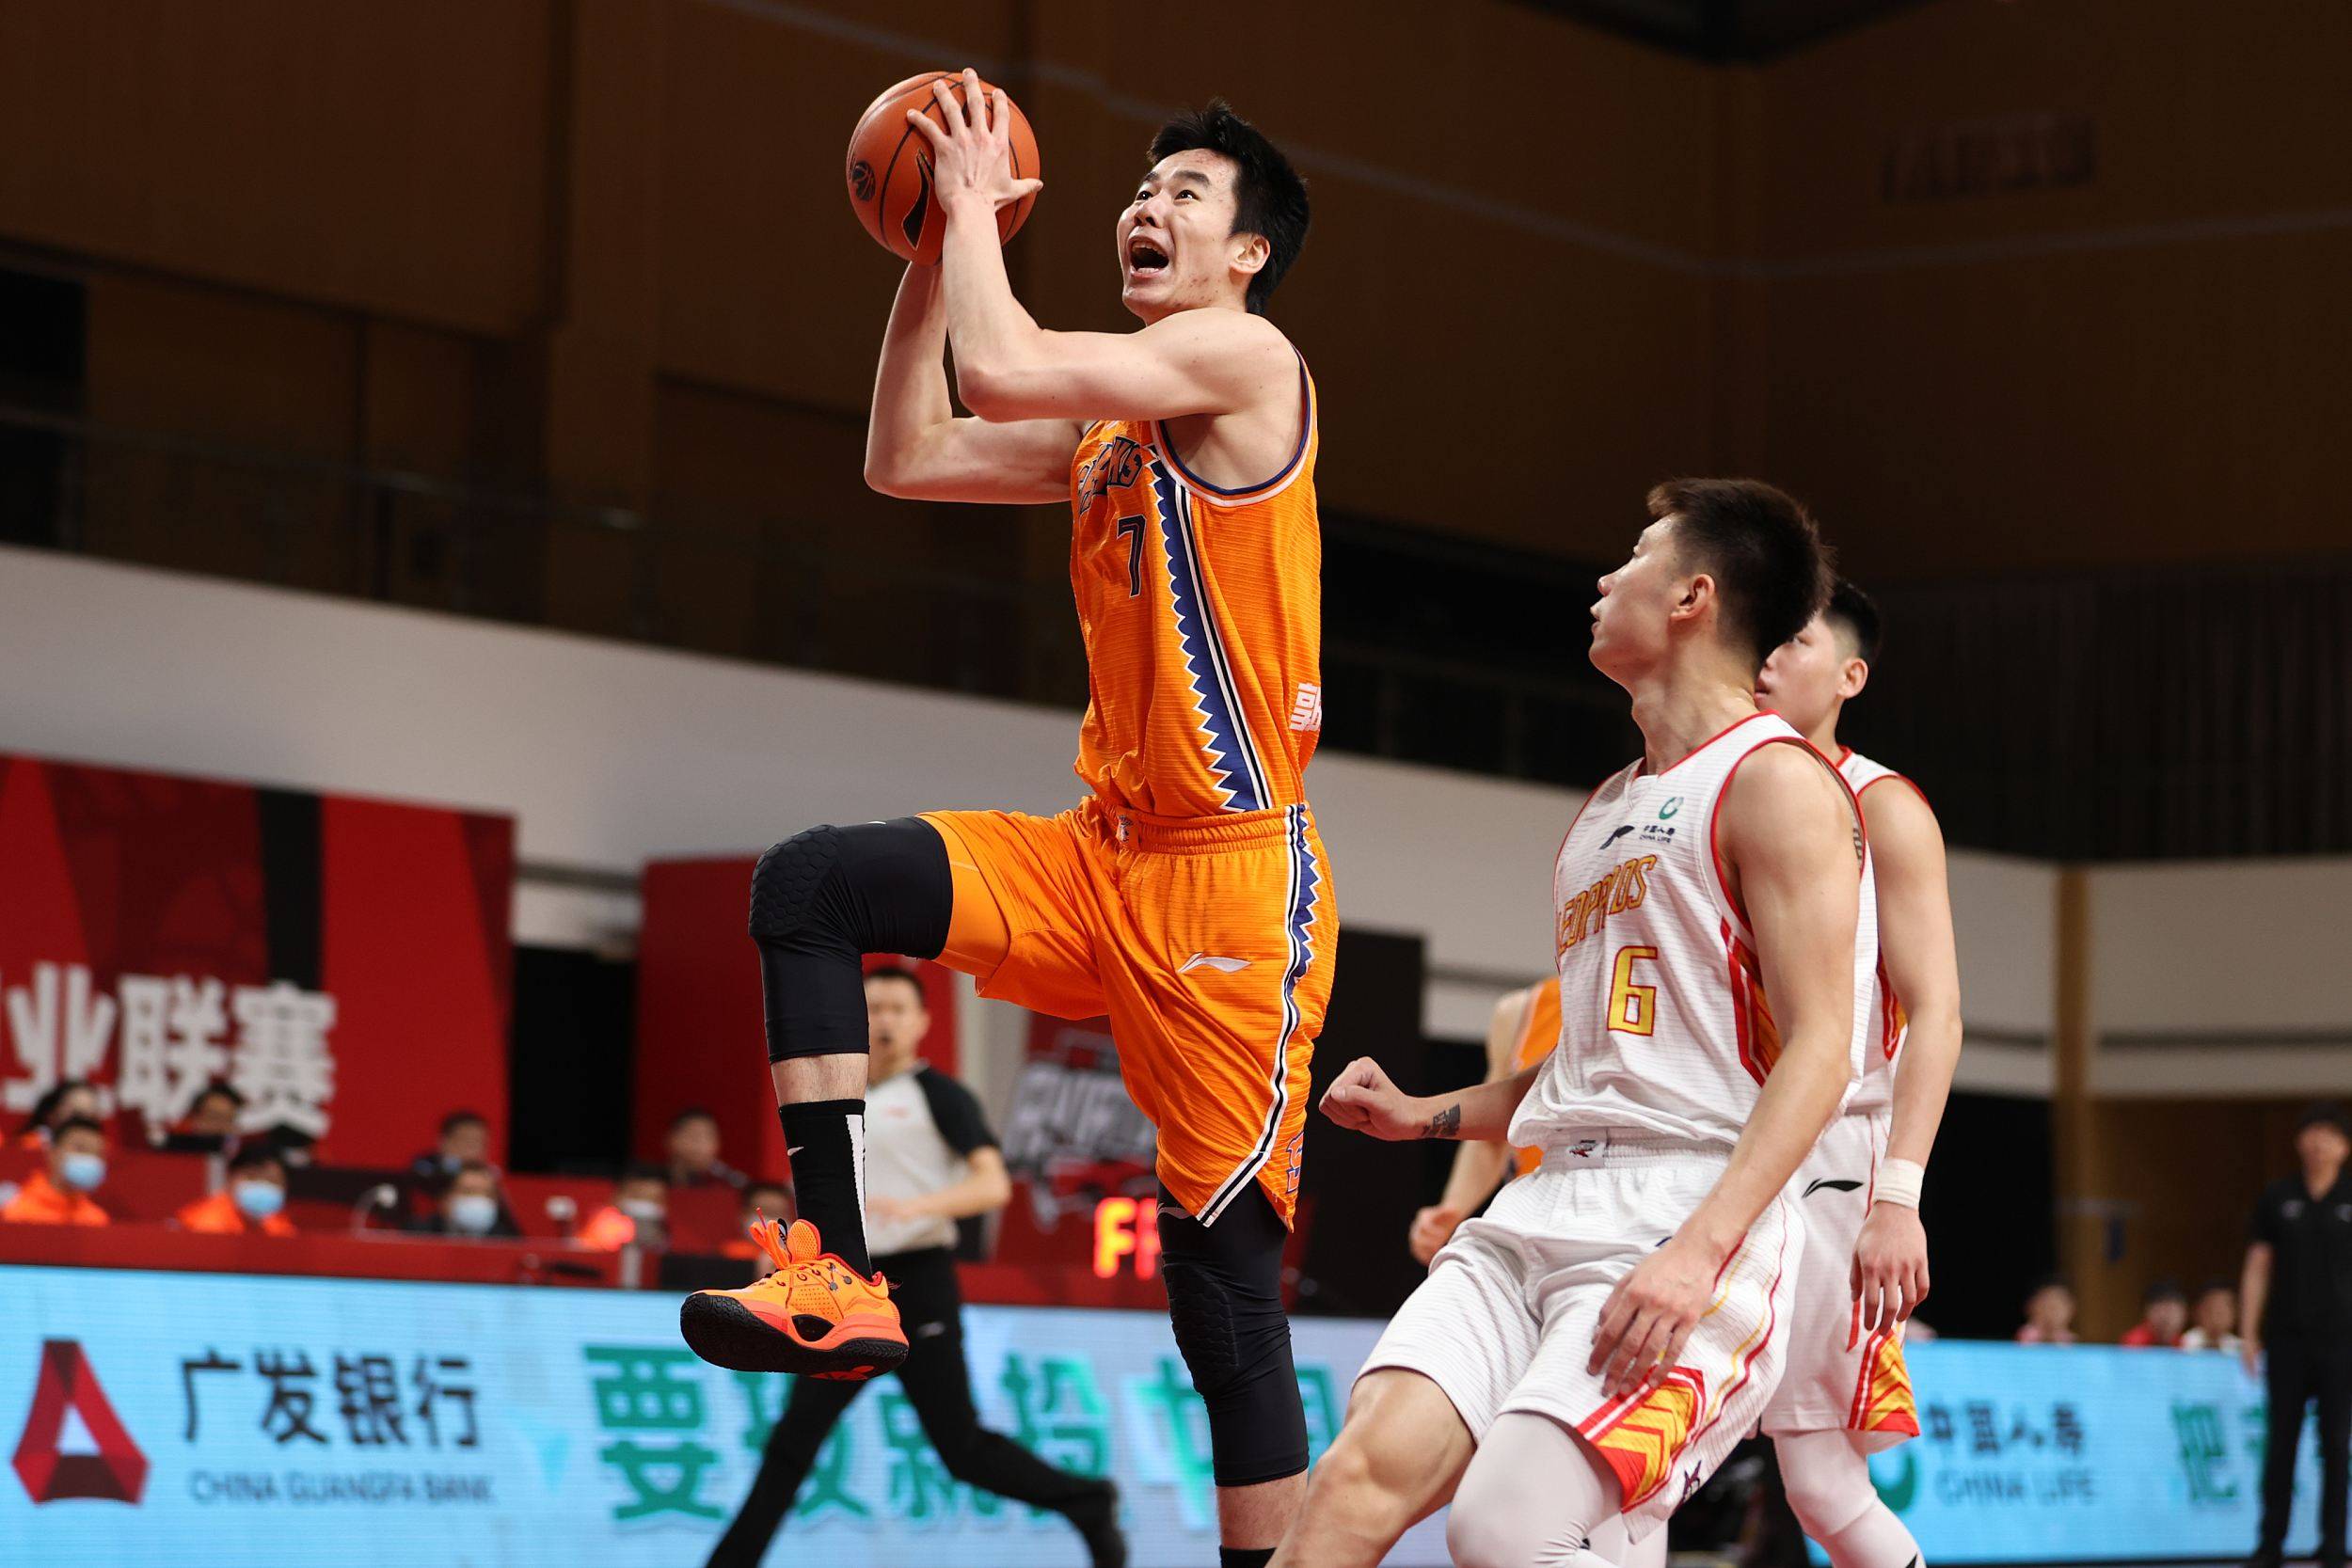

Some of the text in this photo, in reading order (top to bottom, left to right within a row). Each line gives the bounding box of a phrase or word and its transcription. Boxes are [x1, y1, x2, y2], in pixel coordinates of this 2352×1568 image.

[1117, 515, 1147, 597] 7
[1607, 945, 1657, 1037] 6
[3, 961, 336, 1136] 业联赛
[182, 1348, 479, 1448] 广发银行
[192, 1471, 277, 1501] CHINA
[425, 1473, 494, 1503] BANK
